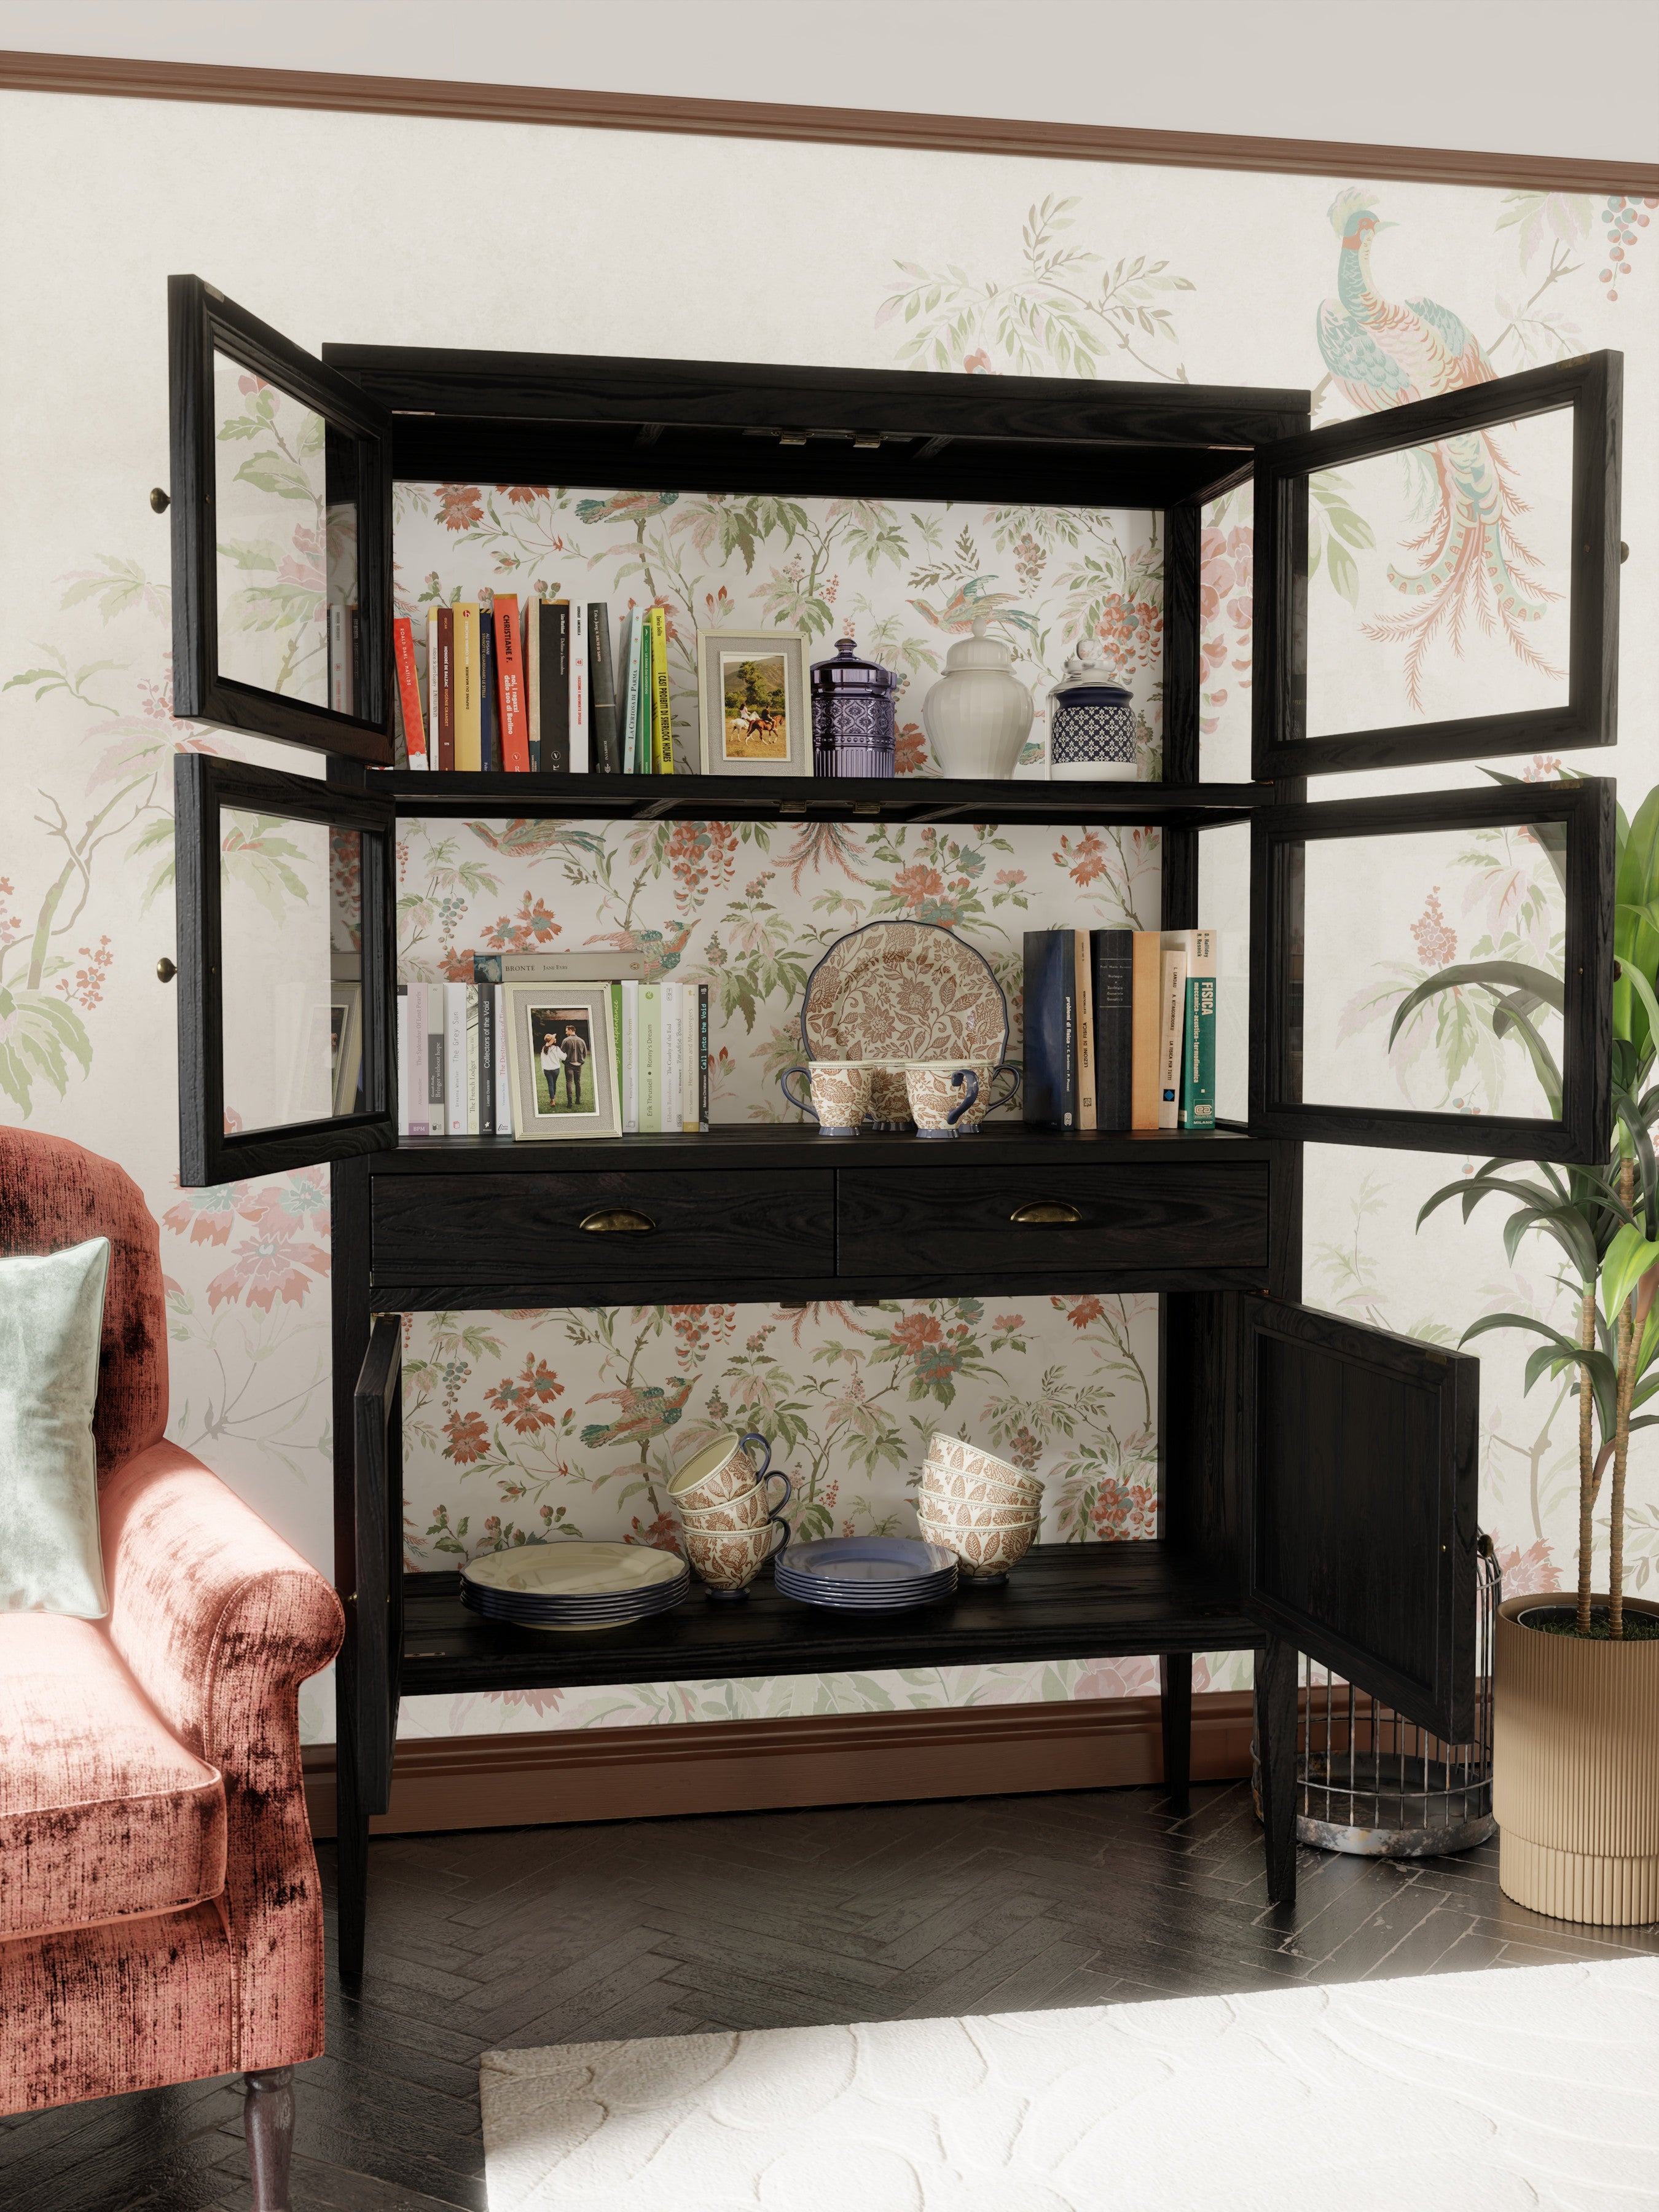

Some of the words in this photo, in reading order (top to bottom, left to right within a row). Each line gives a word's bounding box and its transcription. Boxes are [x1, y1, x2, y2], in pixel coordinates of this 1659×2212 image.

[503, 614, 512, 655] CHRISTIANE
[658, 676, 667, 686] CASI
[659, 688, 669, 709] PROIBITI
[628, 731, 634, 739] LA
[661, 716, 670, 741] SHERLOCK
[662, 742, 672, 763] HOLMES
[1201, 982, 1214, 1016] FISICA
